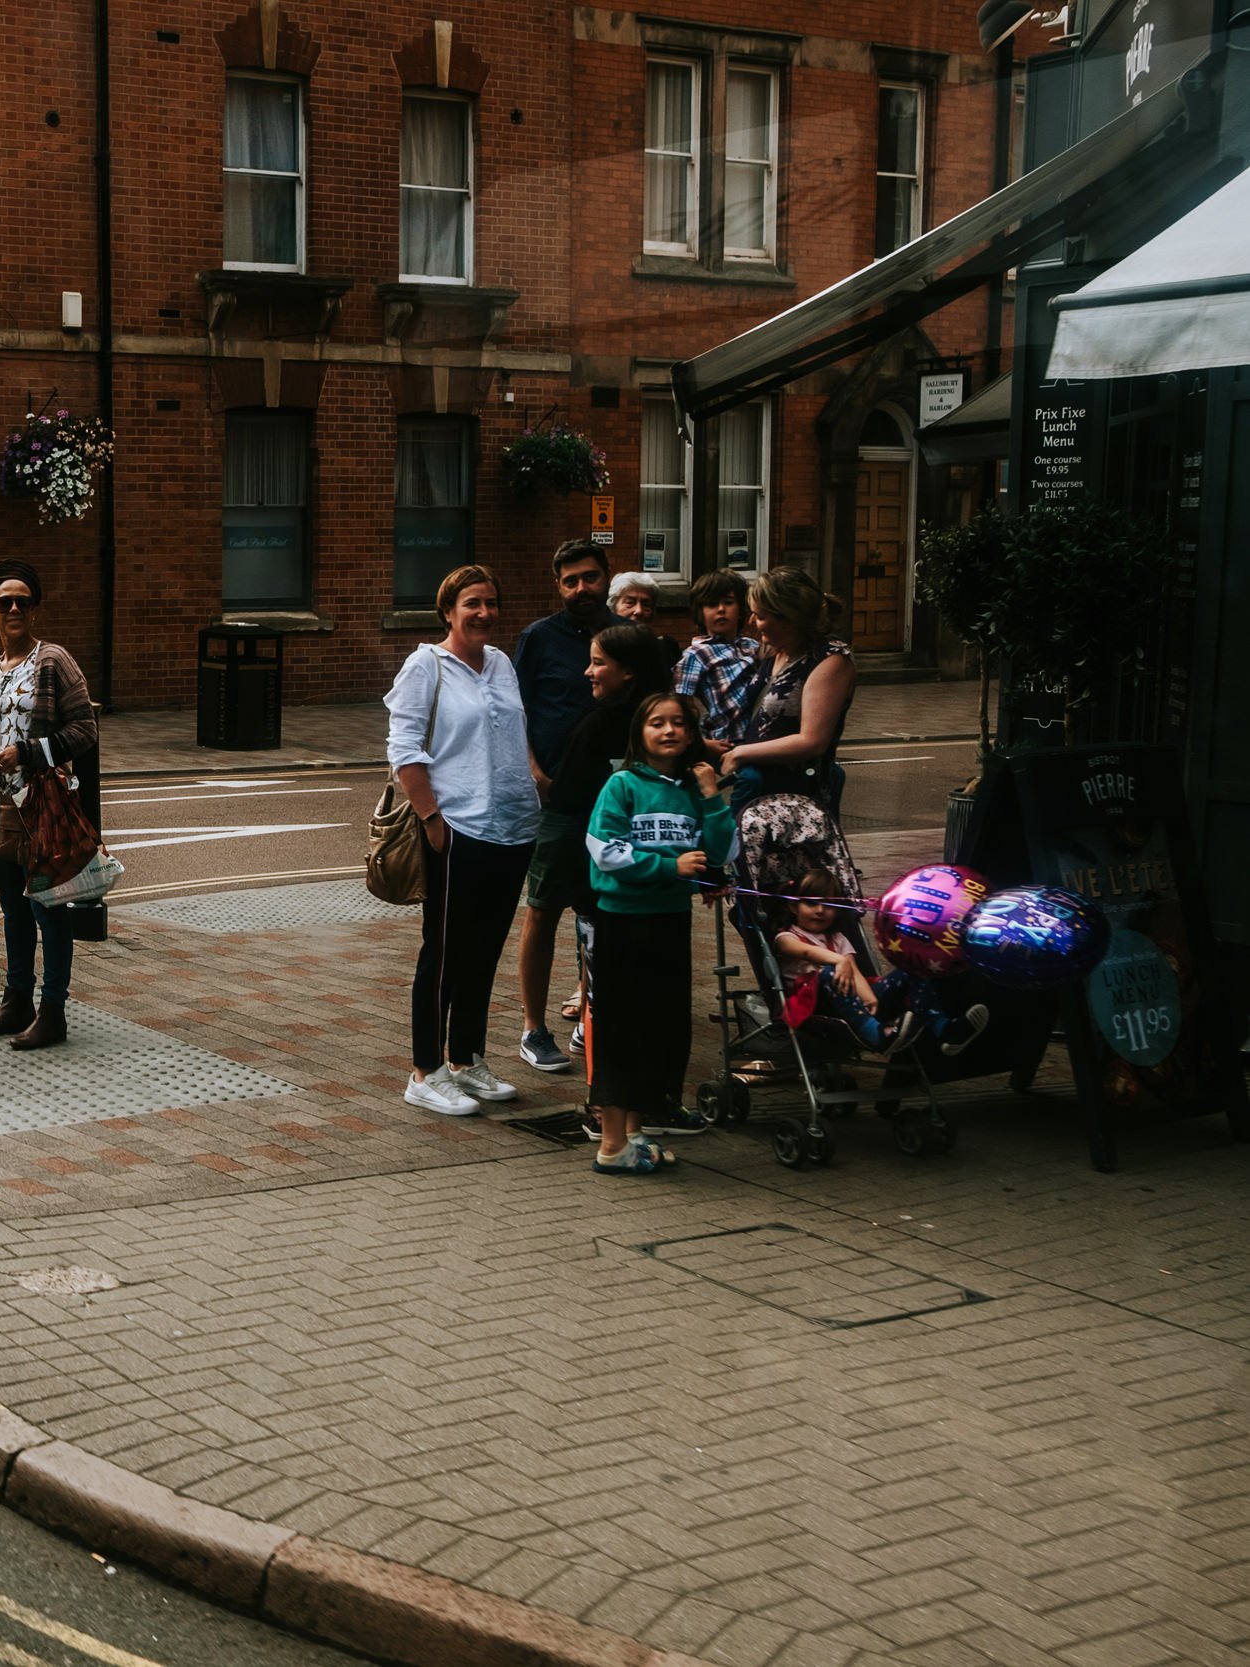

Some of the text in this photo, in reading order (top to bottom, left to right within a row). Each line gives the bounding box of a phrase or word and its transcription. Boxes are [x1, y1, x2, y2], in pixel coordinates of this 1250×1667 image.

[1126, 22, 1154, 97] PIERRE
[1035, 407, 1086, 420] Prix Fixe
[1042, 420, 1077, 432] Lunch
[1042, 436, 1075, 447] Menu
[1034, 456, 1082, 465] One course
[1046, 465, 1069, 475] £9.95
[1031, 480, 1084, 488] Two courses
[1087, 755, 1120, 767] BISTROT
[1081, 773, 1136, 806] PIERRE
[1102, 963, 1161, 988] LUNCH
[1111, 983, 1159, 1007] MENU
[1112, 1006, 1171, 1052] £11.95
